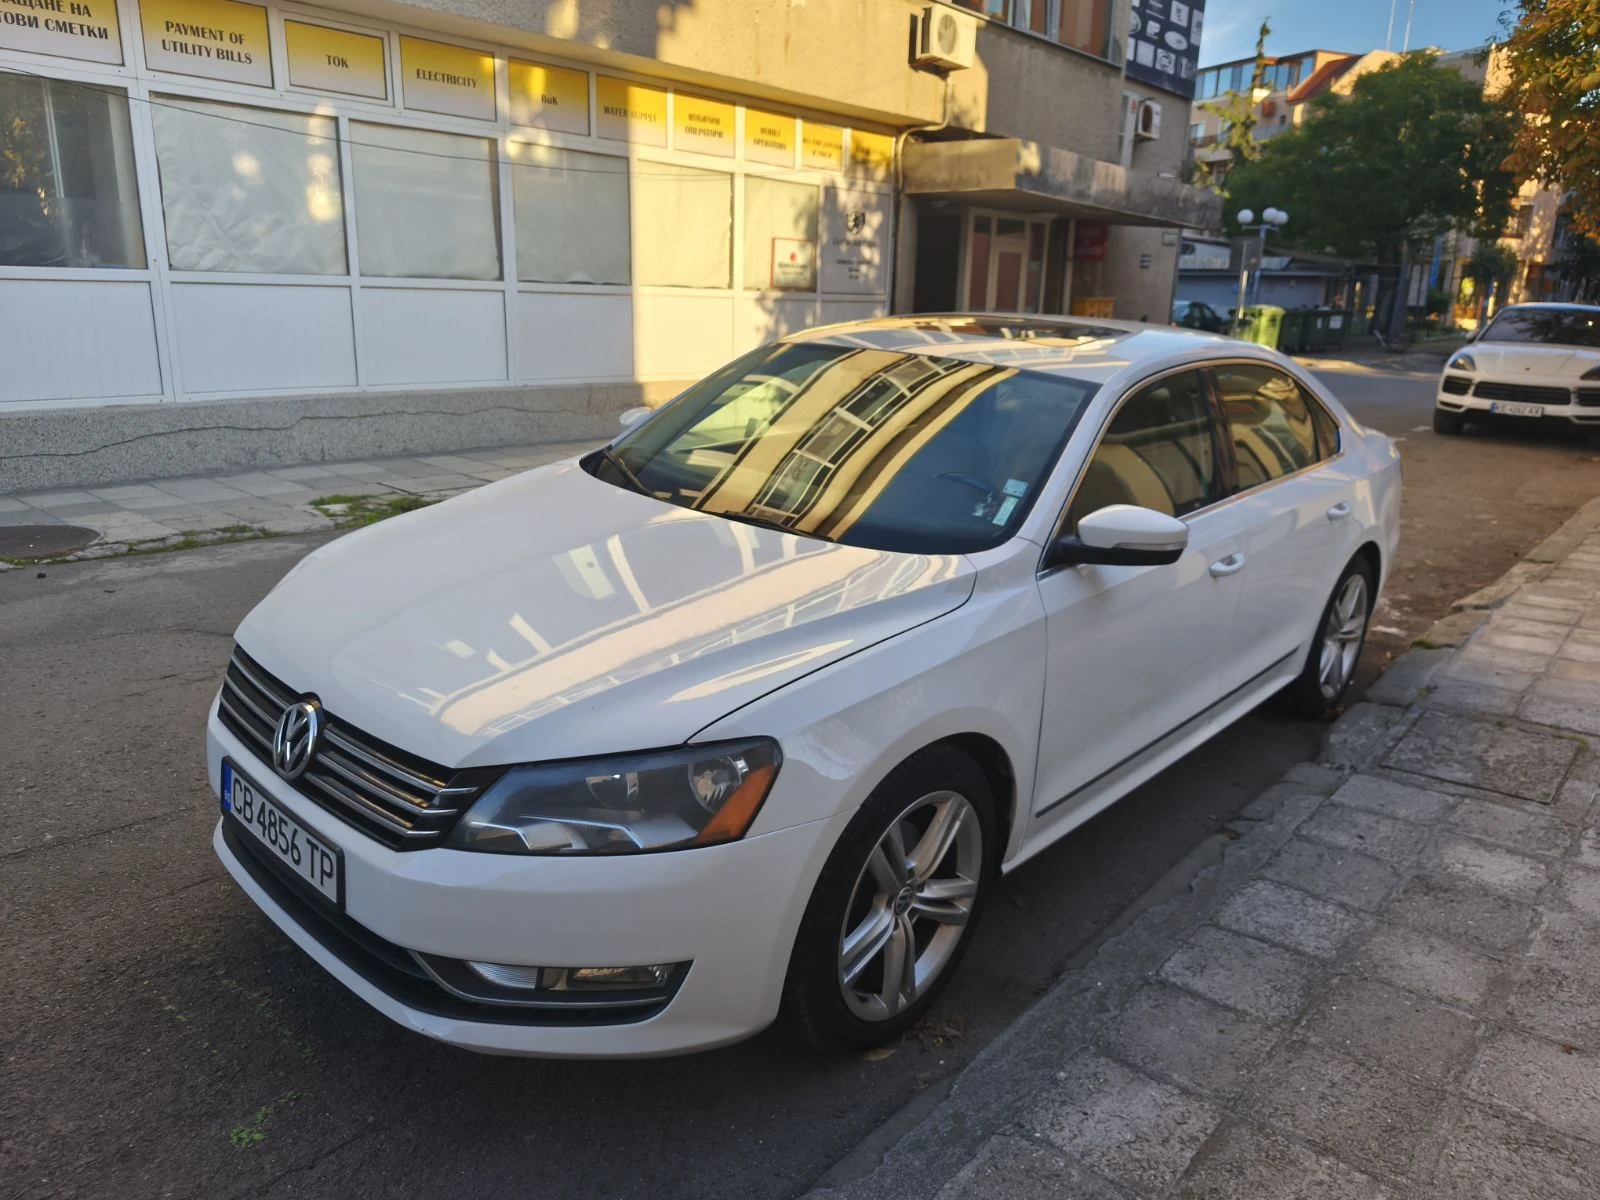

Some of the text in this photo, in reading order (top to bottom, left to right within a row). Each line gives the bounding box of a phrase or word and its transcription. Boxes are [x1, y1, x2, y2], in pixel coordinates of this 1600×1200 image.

[70, 2, 92, 18] НА
[44, 18, 109, 40] СМЕТКИ
[165, 20, 246, 45] PAYMENT OF
[162, 39, 253, 65] UTILITY BILLS
[326, 54, 349, 69] ТОК
[416, 68, 478, 88] ELECTRICITY
[603, 105, 628, 119] WATER
[233, 777, 334, 887] CB 4856 TP
